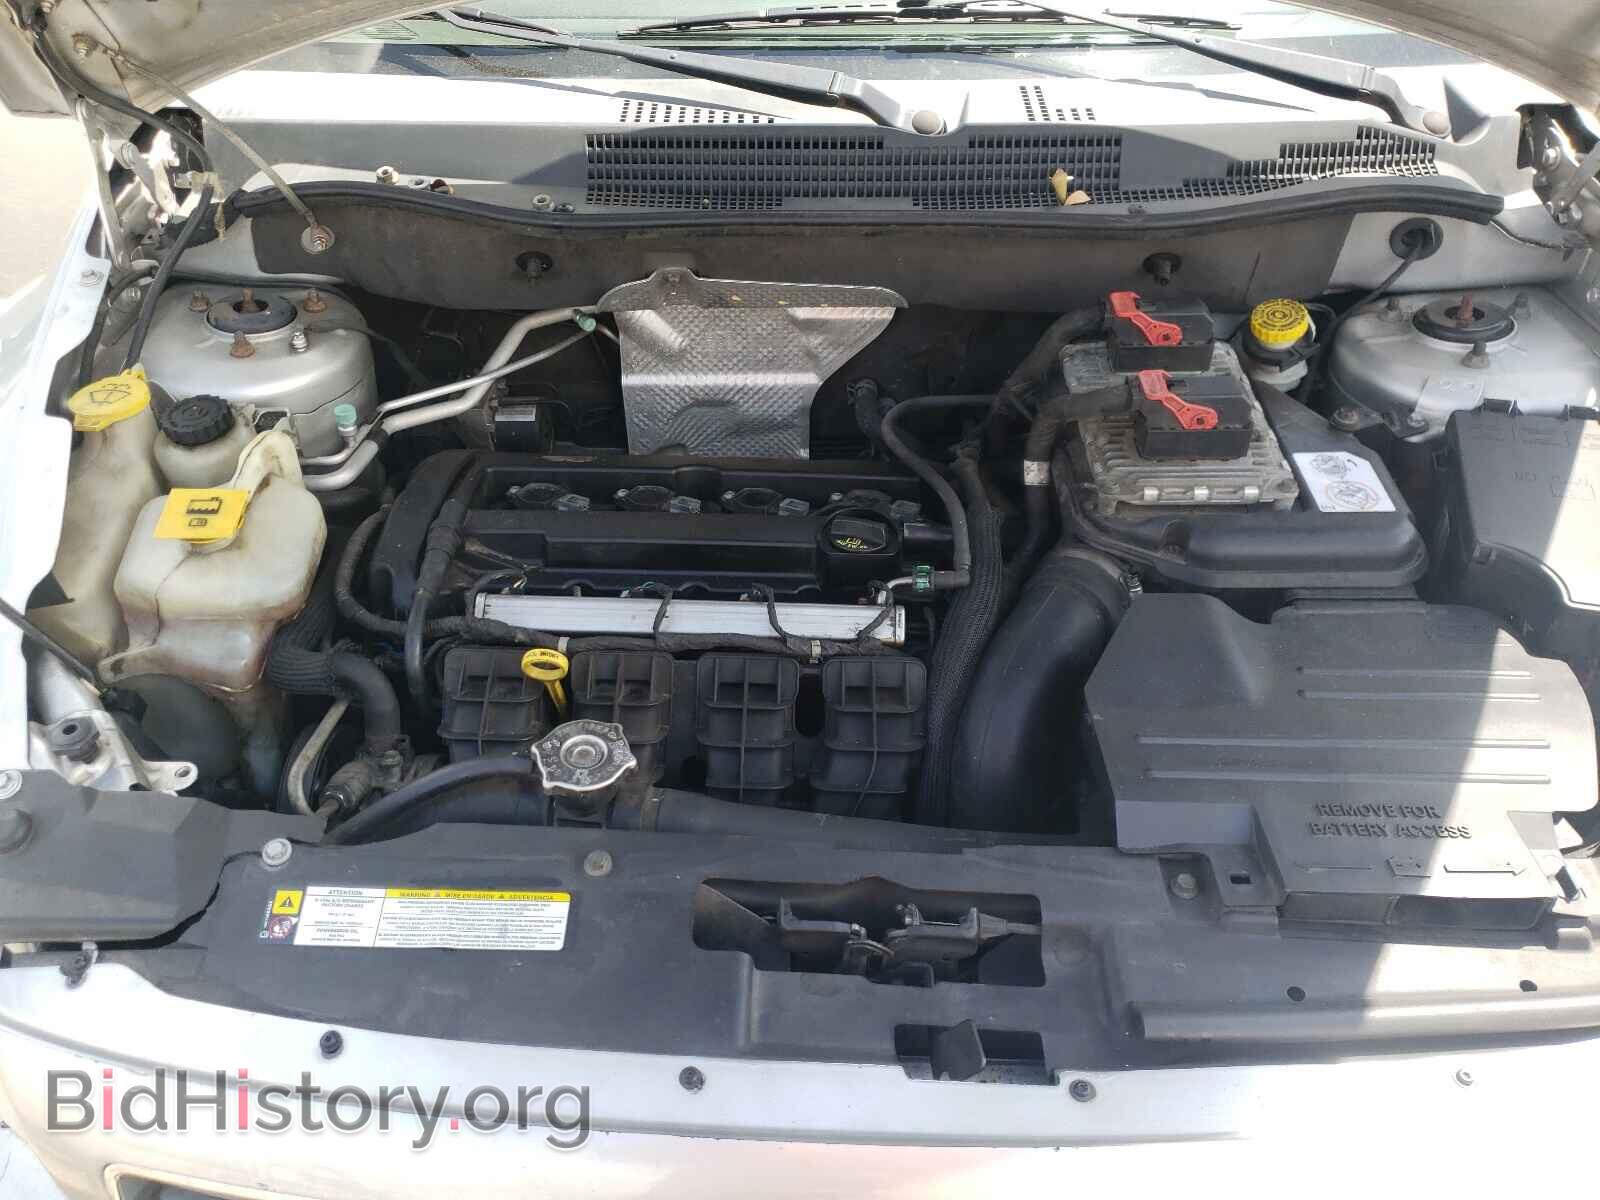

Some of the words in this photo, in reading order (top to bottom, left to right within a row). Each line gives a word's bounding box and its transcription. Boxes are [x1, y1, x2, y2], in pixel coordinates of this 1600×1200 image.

[1315, 803, 1397, 818] REMOVE
[1400, 805, 1441, 819] FOR
[1309, 822, 1389, 838] BATTERY
[1396, 823, 1472, 839] ACCESS
